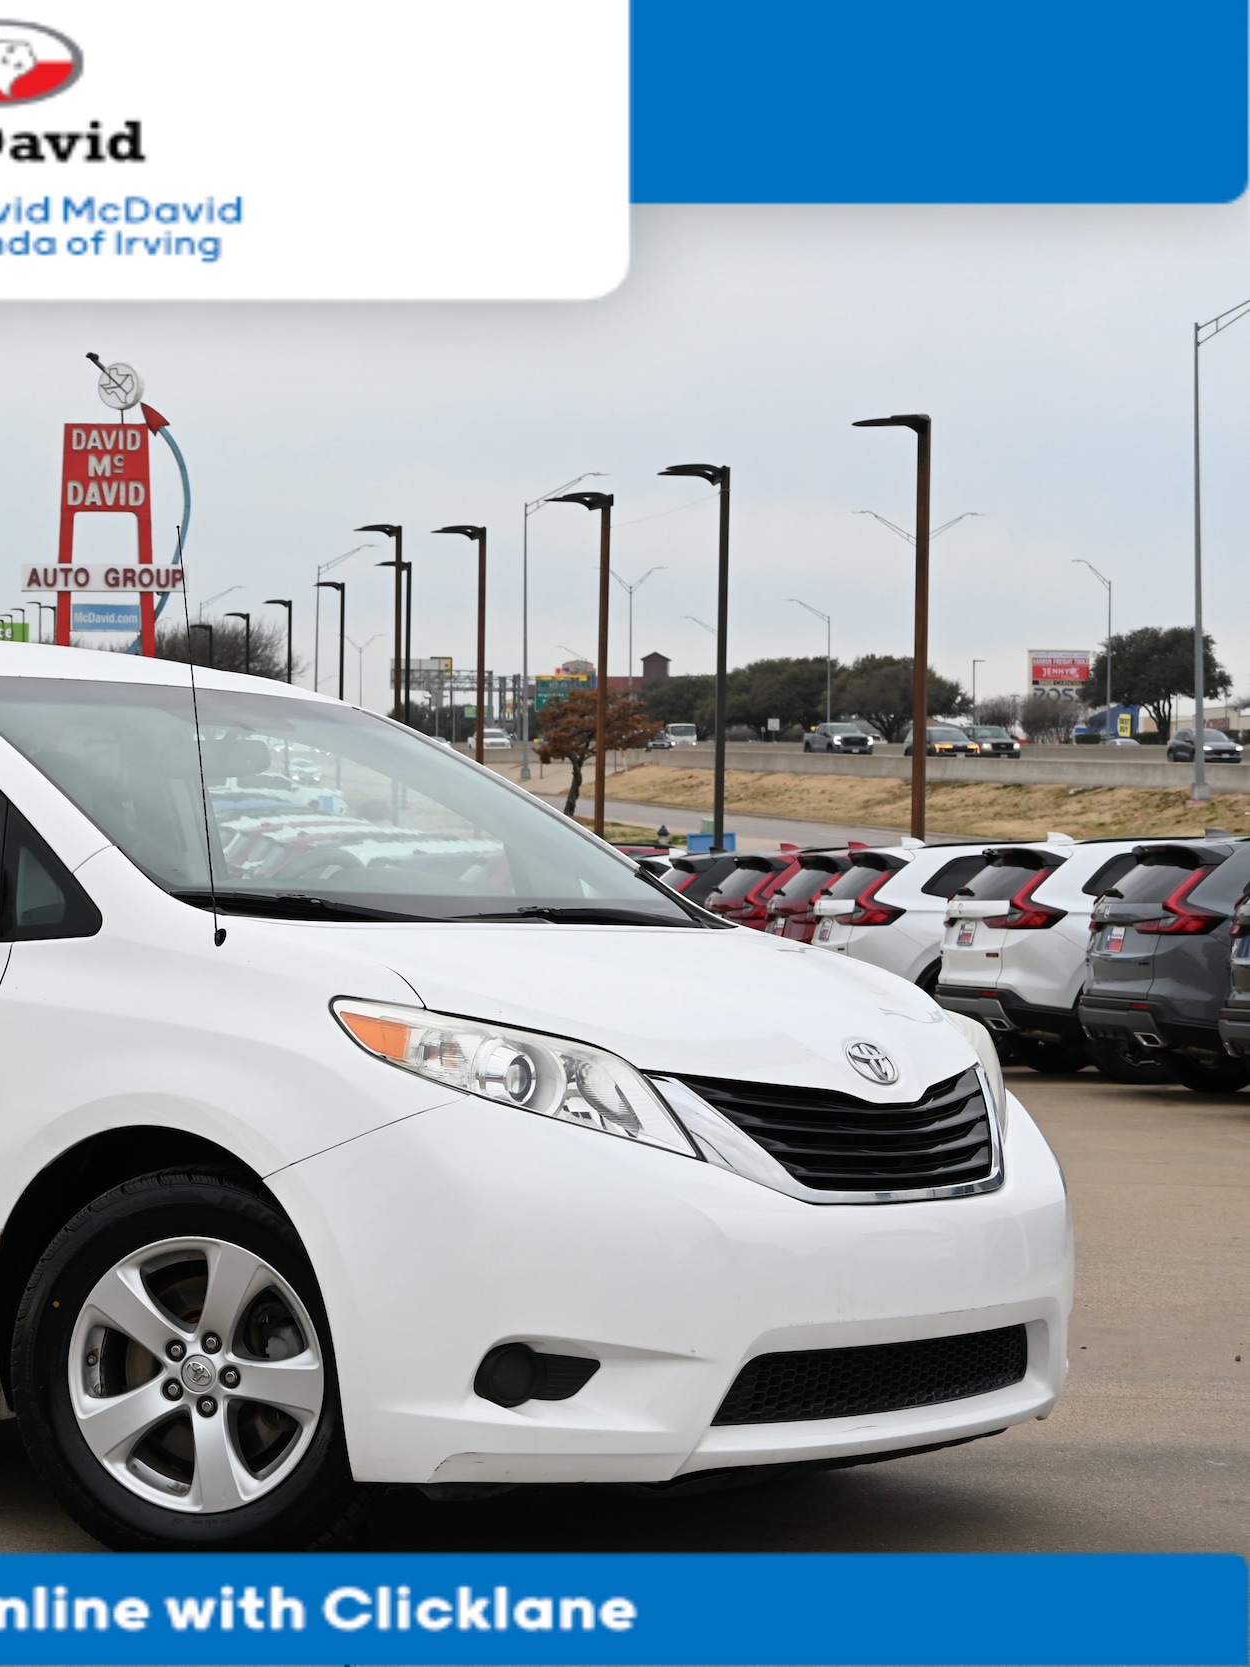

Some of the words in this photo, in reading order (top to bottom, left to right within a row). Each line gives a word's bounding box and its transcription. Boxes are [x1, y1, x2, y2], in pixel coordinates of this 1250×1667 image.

[72, 428, 141, 451] DAVID
[67, 480, 146, 507] DAVID
[27, 568, 90, 588] AUTO
[104, 568, 183, 589] GROUP
[74, 612, 138, 624] McDavid.com
